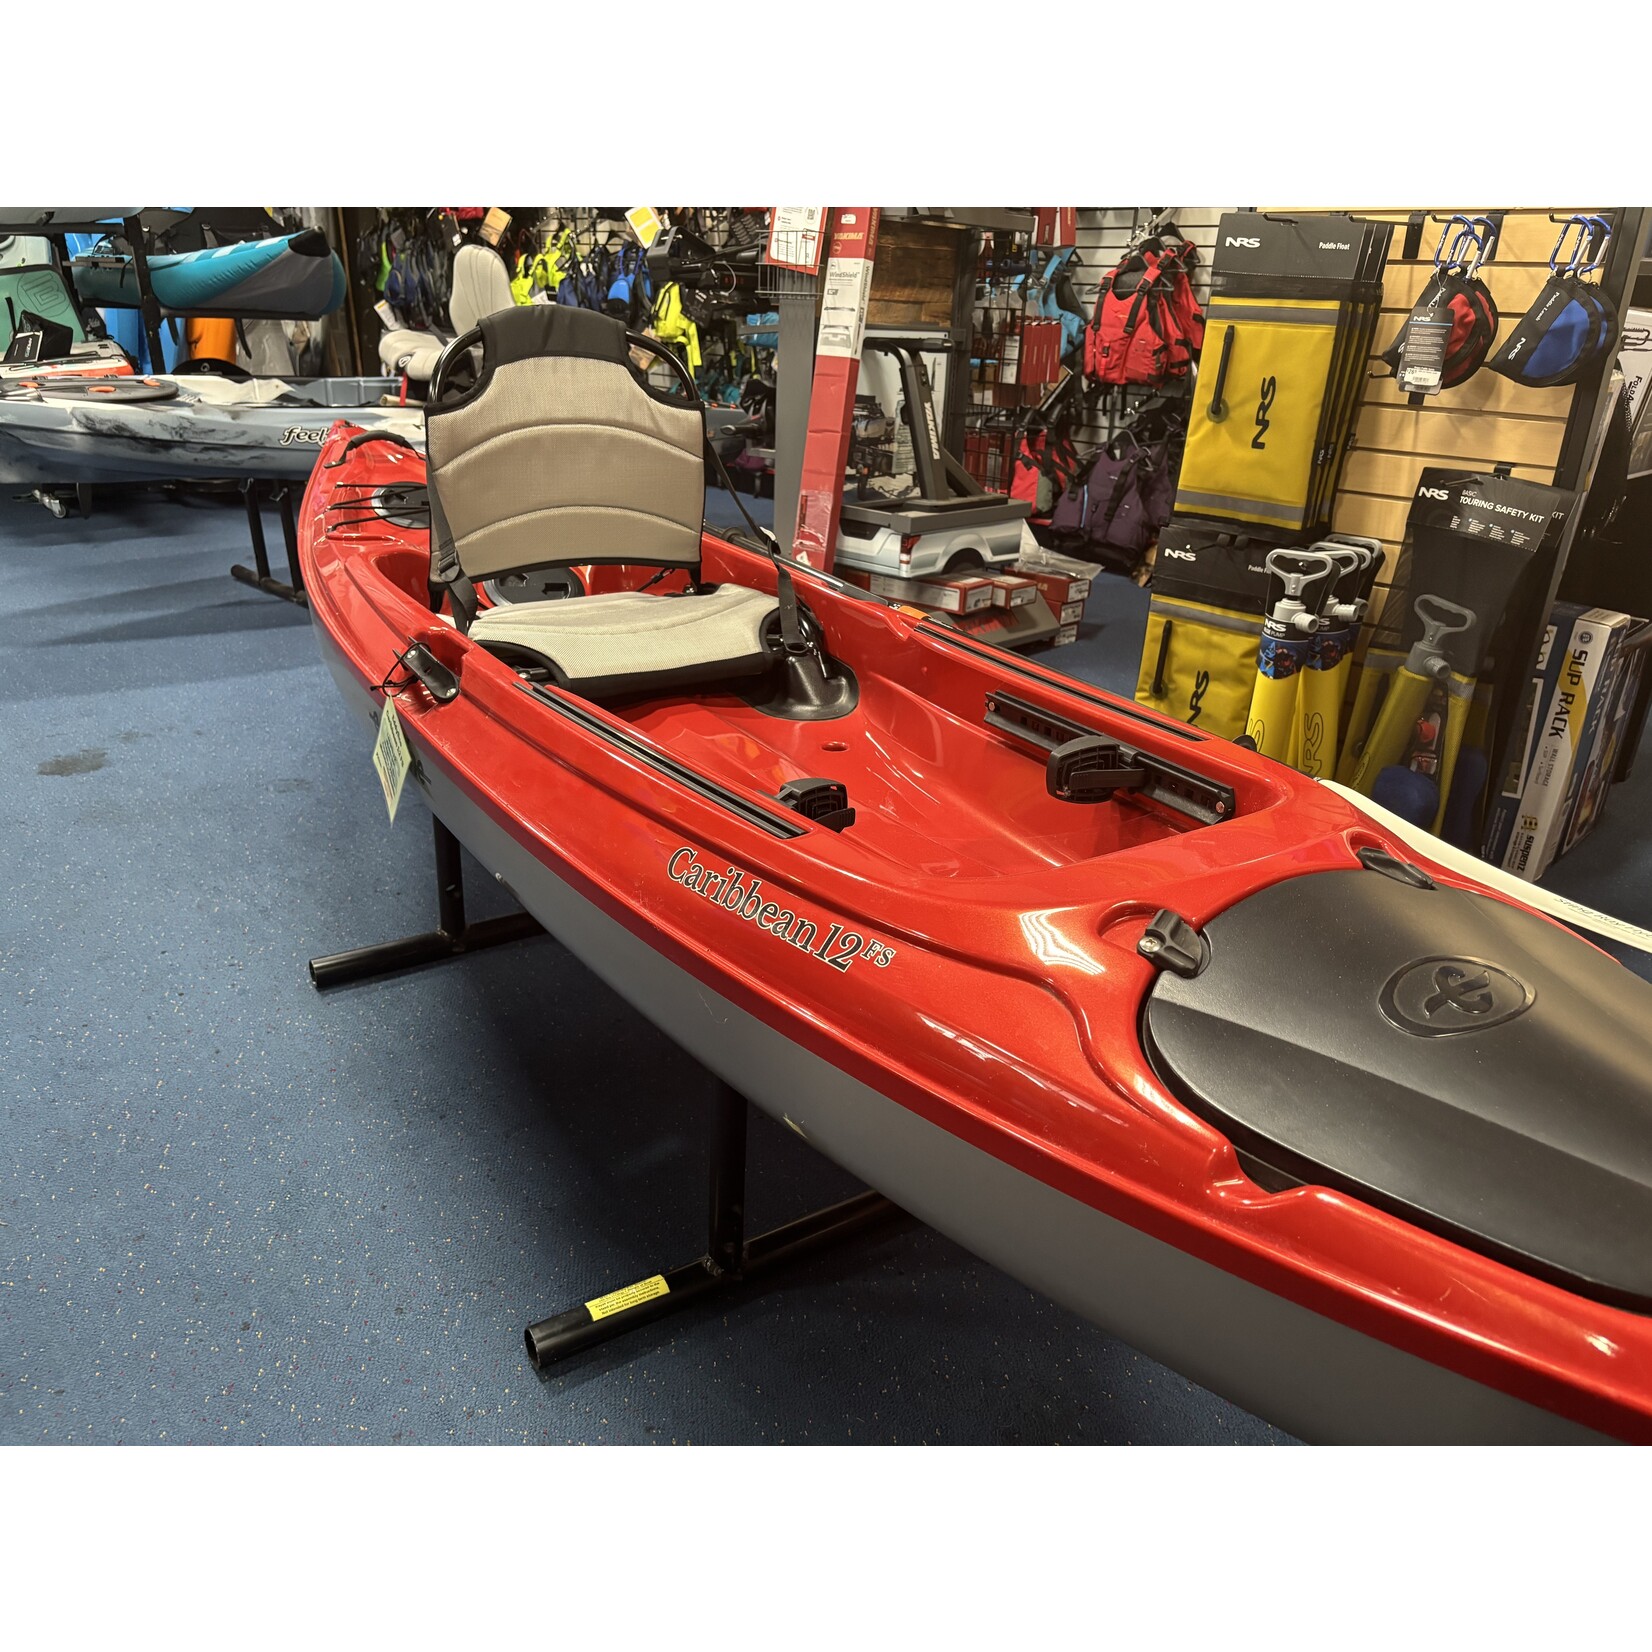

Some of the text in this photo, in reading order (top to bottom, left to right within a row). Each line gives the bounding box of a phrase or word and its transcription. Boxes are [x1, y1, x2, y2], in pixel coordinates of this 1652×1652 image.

[834, 232, 864, 240] YAKIMA
[1225, 236, 1260, 248] NRS
[1318, 241, 1350, 250] Paddle Float
[1508, 337, 1526, 360] NRS
[1251, 376, 1277, 450] NRS
[280, 426, 331, 448] feel
[924, 402, 940, 460] YAKIMA
[1418, 486, 1449, 500] NRS
[1462, 489, 1478, 498] BASIC
[1460, 496, 1545, 524] TOURING SAFETY KIT
[1164, 548, 1196, 562] NRS
[1264, 618, 1287, 632] NRS
[1548, 648, 1589, 740] SUP RACK
[1517, 834, 1534, 872] suspenz
[667, 847, 897, 973] Caribbean 12 FS
